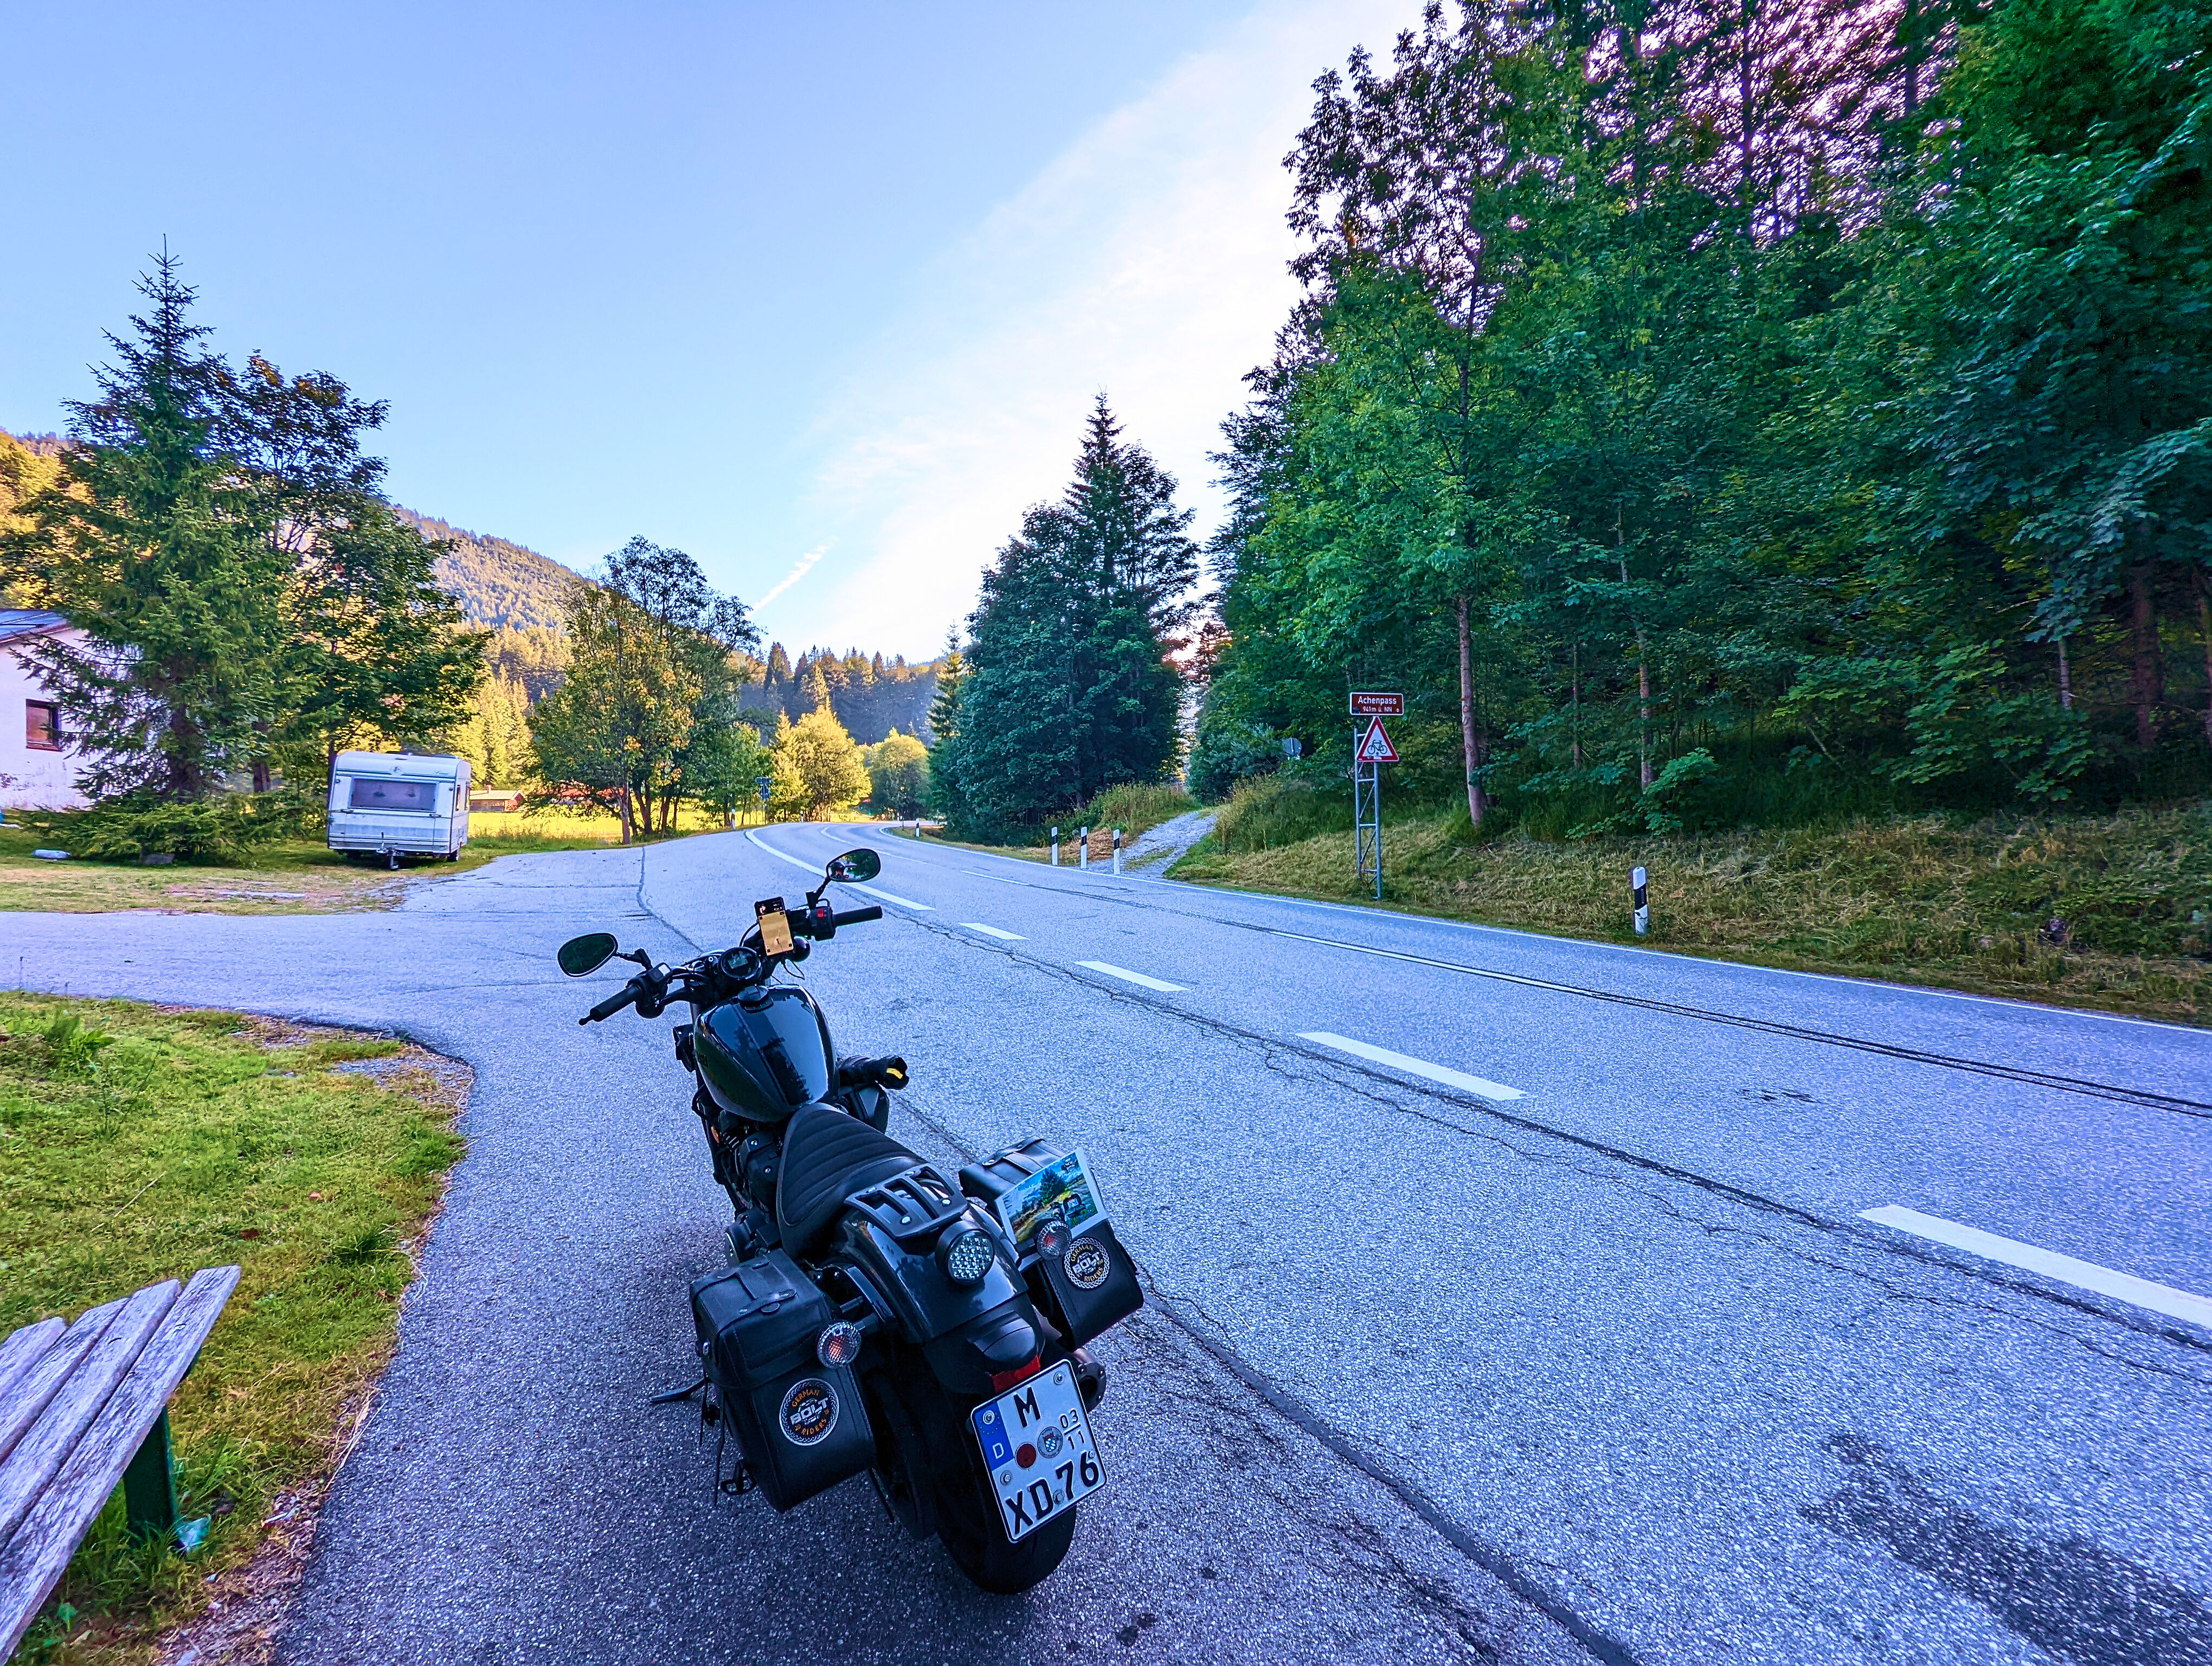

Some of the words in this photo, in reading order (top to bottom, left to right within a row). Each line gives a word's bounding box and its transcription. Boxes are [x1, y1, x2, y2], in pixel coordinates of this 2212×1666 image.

[1358, 696, 1397, 706] Achenpass
[1070, 1244, 1094, 1261] GERMAN
[1072, 1252, 1099, 1274] BOLT
[1084, 1267, 1103, 1281] RIDERS
[792, 1389, 820, 1407] GERMAN
[1013, 1386, 1041, 1427] M
[790, 1397, 828, 1425] BOLT
[1060, 1409, 1078, 1428] 03
[801, 1418, 827, 1436] RIDERS
[1068, 1430, 1084, 1450] 11
[993, 1442, 1004, 1459] D
